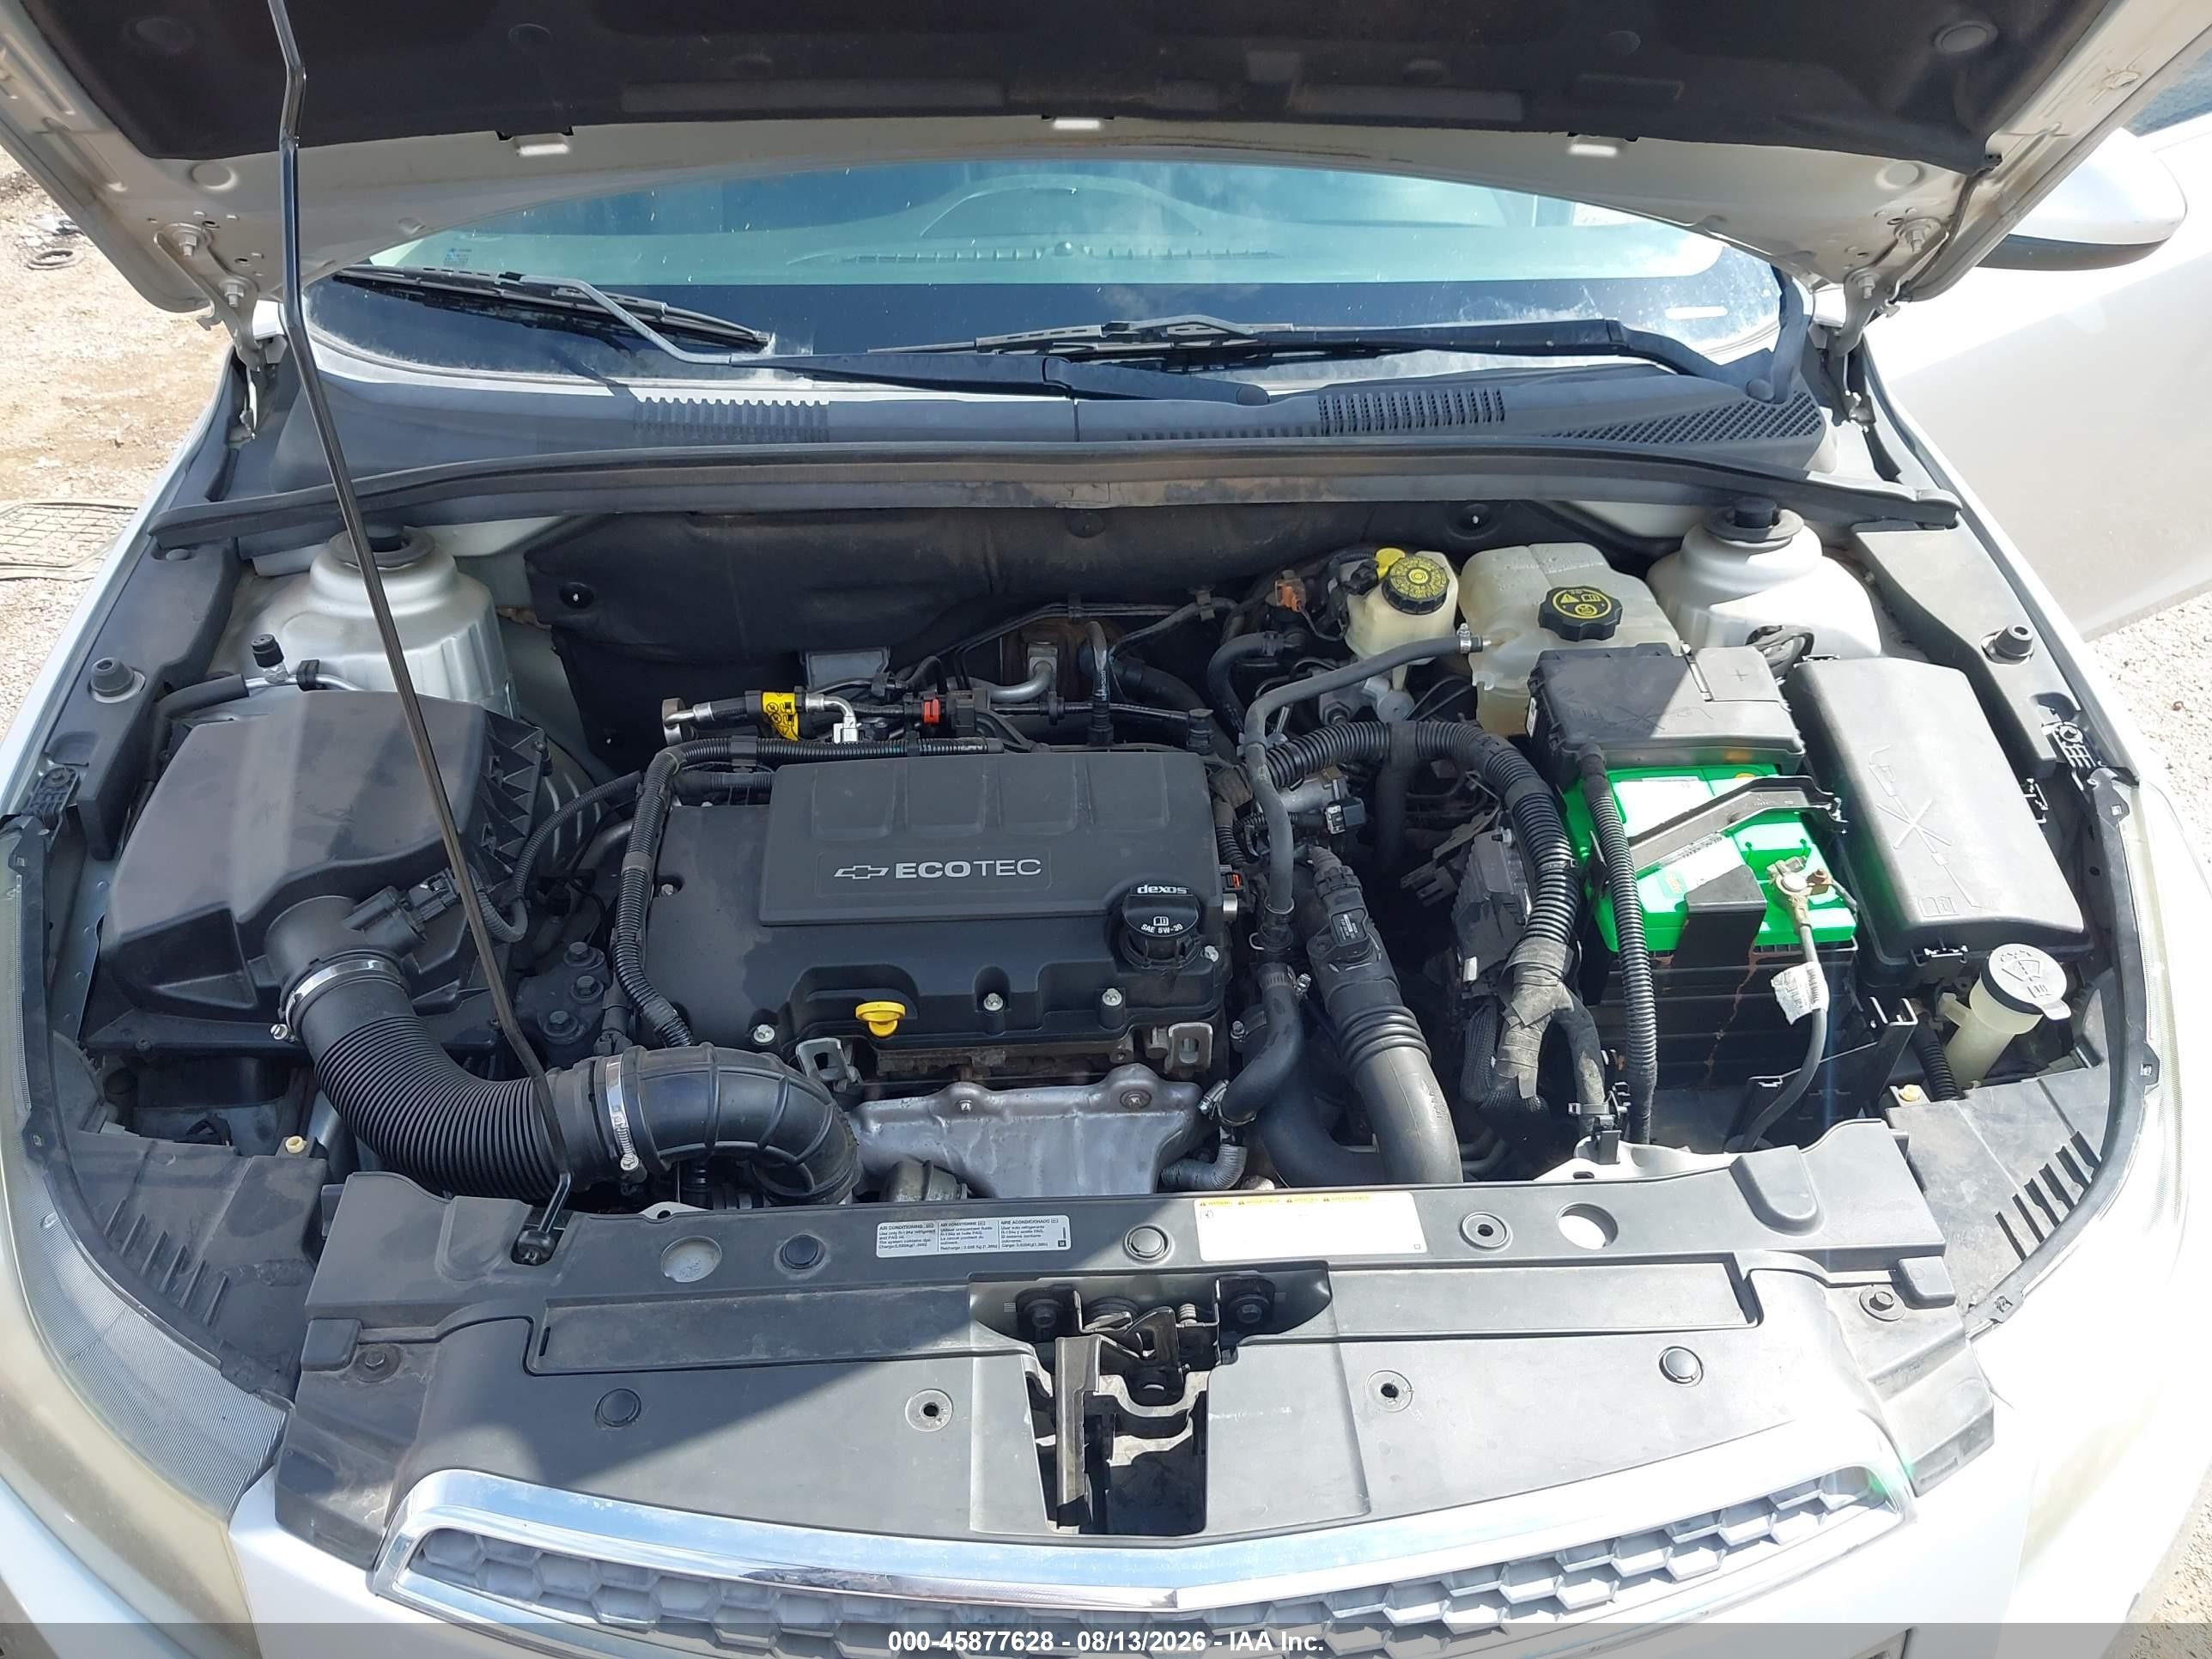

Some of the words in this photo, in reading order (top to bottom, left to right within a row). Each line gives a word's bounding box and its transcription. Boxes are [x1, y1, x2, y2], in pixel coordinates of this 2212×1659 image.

[895, 859, 1042, 879] ECOTEC
[1137, 884, 1189, 894] dexos
[1140, 923, 1156, 933] SAE
[1158, 923, 1183, 934] 5W-30
